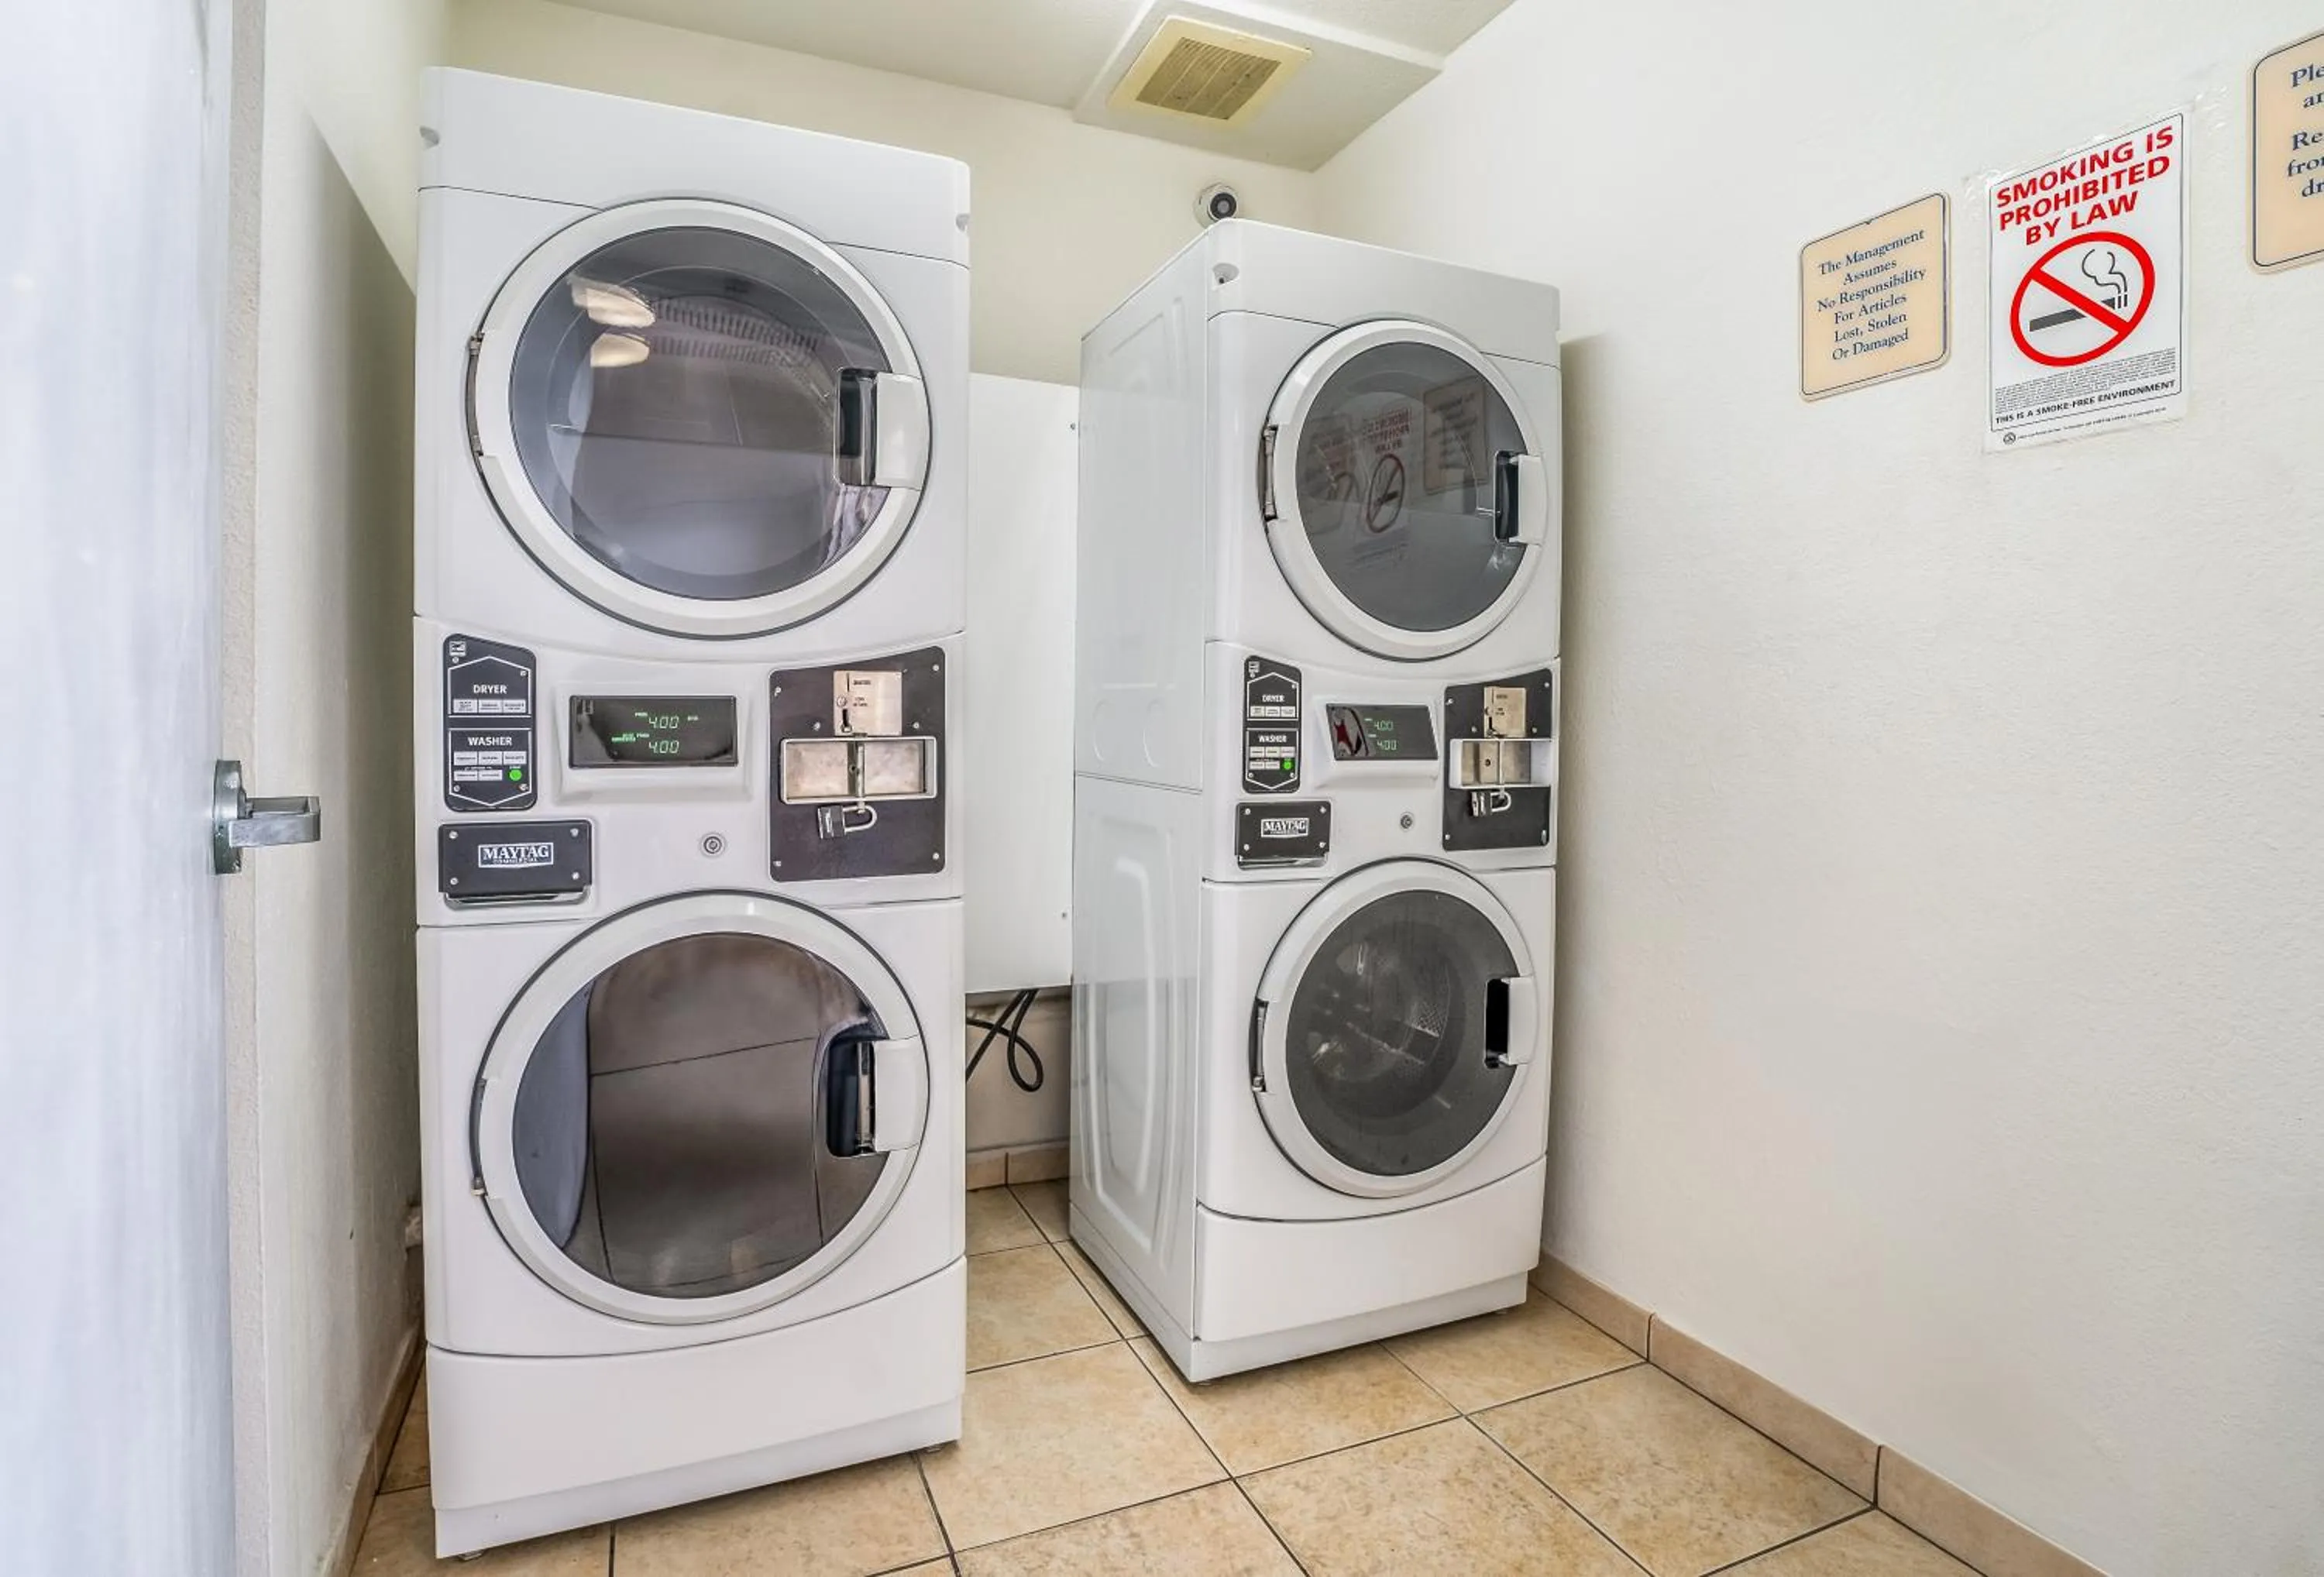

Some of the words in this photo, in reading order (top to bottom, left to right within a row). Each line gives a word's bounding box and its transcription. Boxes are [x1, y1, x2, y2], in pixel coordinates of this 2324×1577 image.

[1996, 141, 2133, 208] SMOKING
[2145, 125, 2173, 153] IS
[2287, 157, 2324, 177] fro
[1999, 156, 2170, 231] PROHIBITED
[2026, 217, 2061, 245] BY
[2071, 191, 2138, 229] LAW
[1818, 261, 1841, 275] The
[1845, 230, 1925, 267] Management
[1844, 260, 1897, 285] Assumes
[1817, 299, 1836, 311] No
[1840, 269, 1926, 303] Responsibility
[1834, 311, 1855, 324] For
[1859, 294, 1907, 317] Articles
[1834, 327, 1863, 342] Lost,
[1868, 314, 1907, 332] Stolen
[1832, 349, 1850, 360] Or
[1853, 328, 1909, 356] Damaged
[1996, 415, 2014, 424] THIS
[2036, 396, 2095, 415] SMOKE-FREE
[2098, 380, 2175, 402] ENVIRONMENT
[473, 685, 507, 694] DRYER
[468, 737, 512, 746] WASHER
[1264, 821, 1305, 831] MAYTAG
[483, 845, 548, 861] MAYTAG
